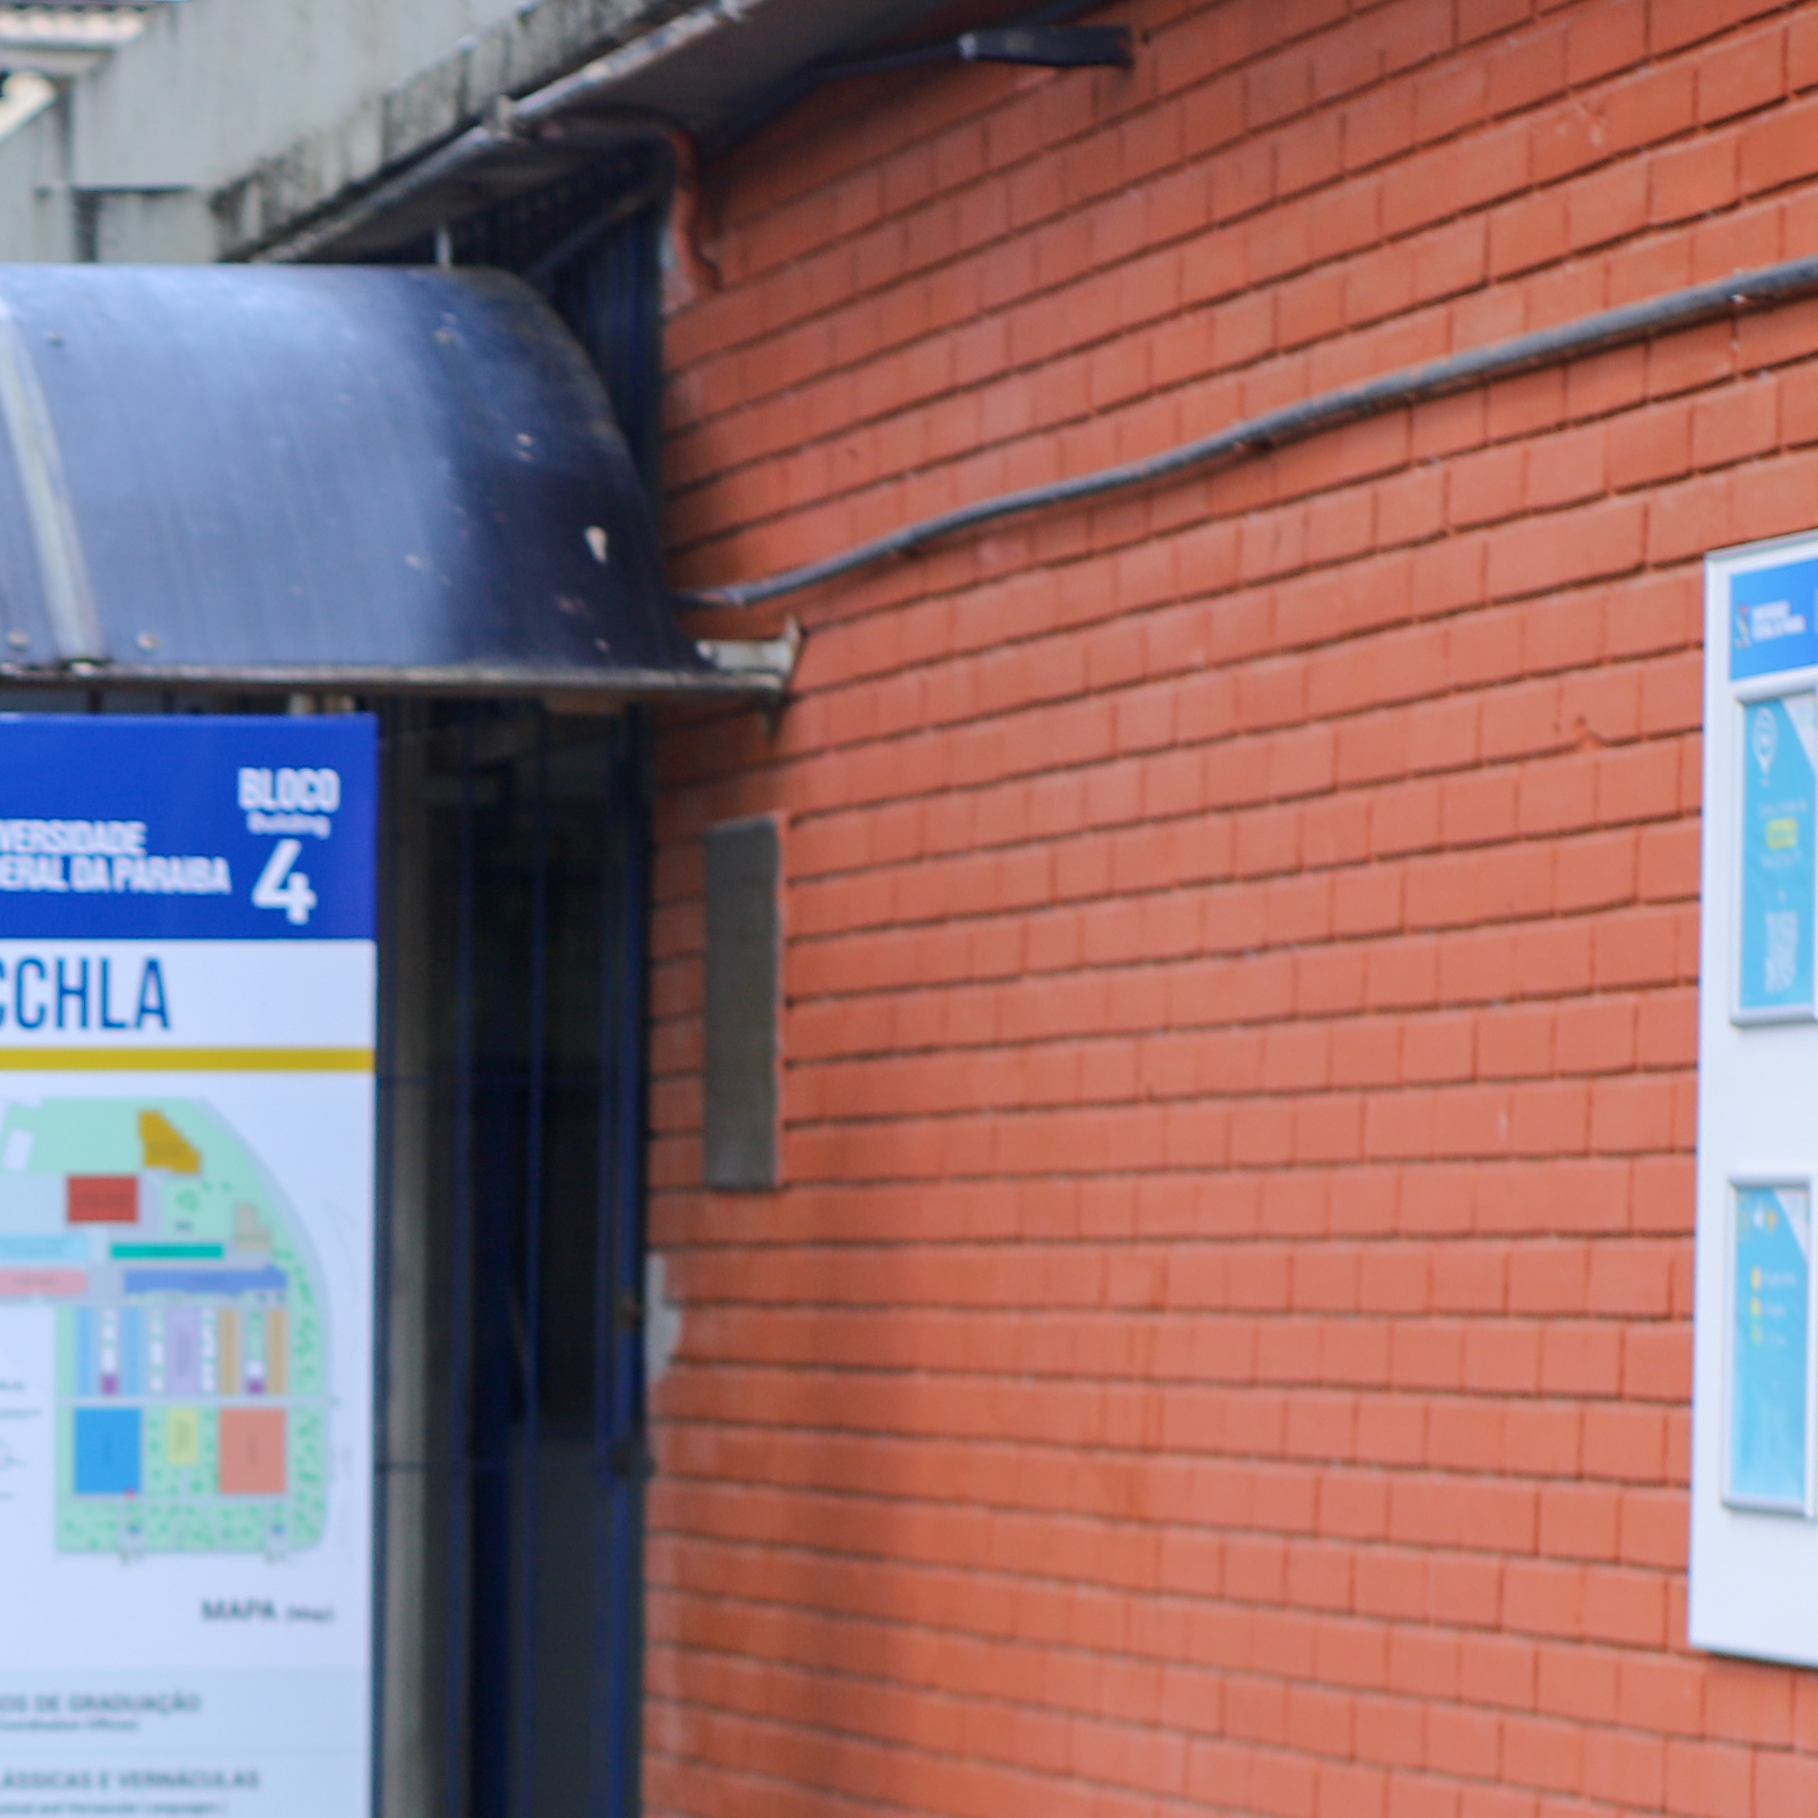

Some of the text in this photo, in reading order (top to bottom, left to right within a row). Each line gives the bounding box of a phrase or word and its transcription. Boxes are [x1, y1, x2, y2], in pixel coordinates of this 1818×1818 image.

[239, 767, 341, 813] BLOCO
[70, 857, 111, 892] DA
[252, 839, 316, 925] 4
[201, 1598, 277, 1620] MAPA
